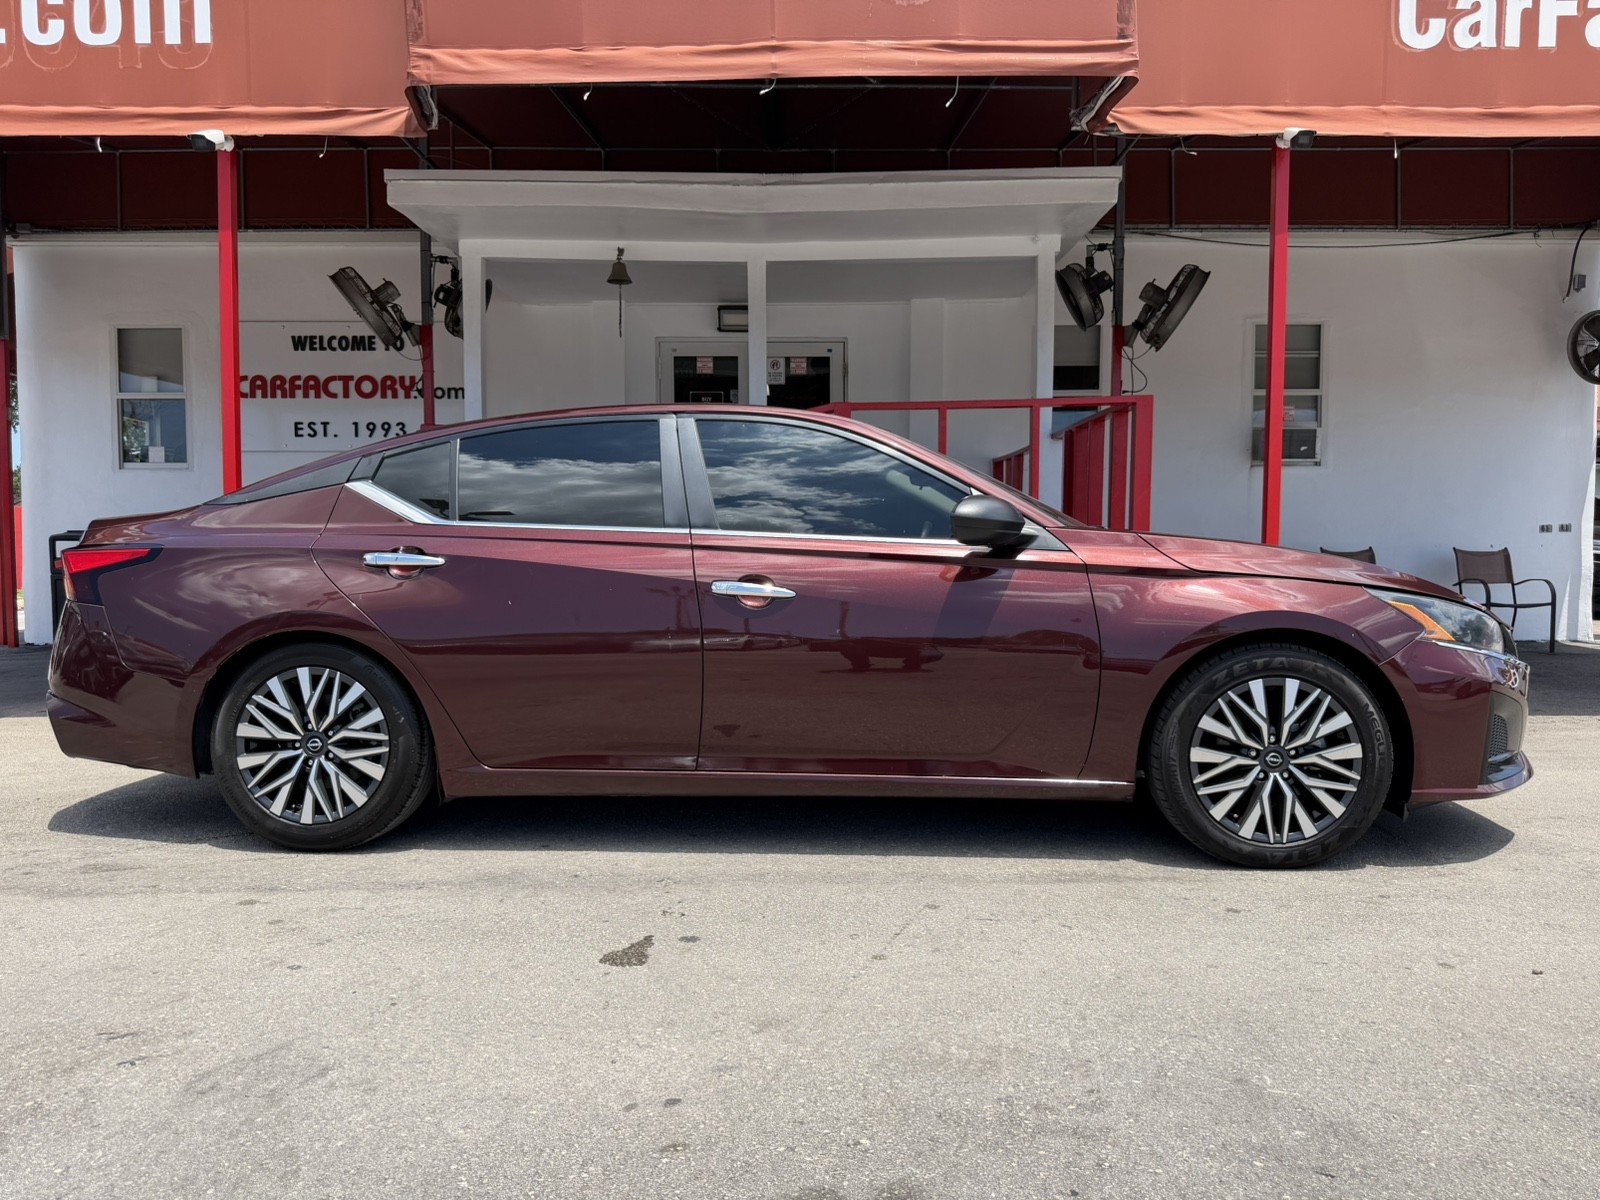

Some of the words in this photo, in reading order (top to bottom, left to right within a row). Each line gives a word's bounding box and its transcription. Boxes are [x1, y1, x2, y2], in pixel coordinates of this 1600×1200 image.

[291, 335, 376, 352] WELCOME
[382, 335, 405, 351] O
[294, 421, 338, 438] EST.
[352, 421, 407, 438] 1993
[1212, 656, 1289, 688] ZETA
